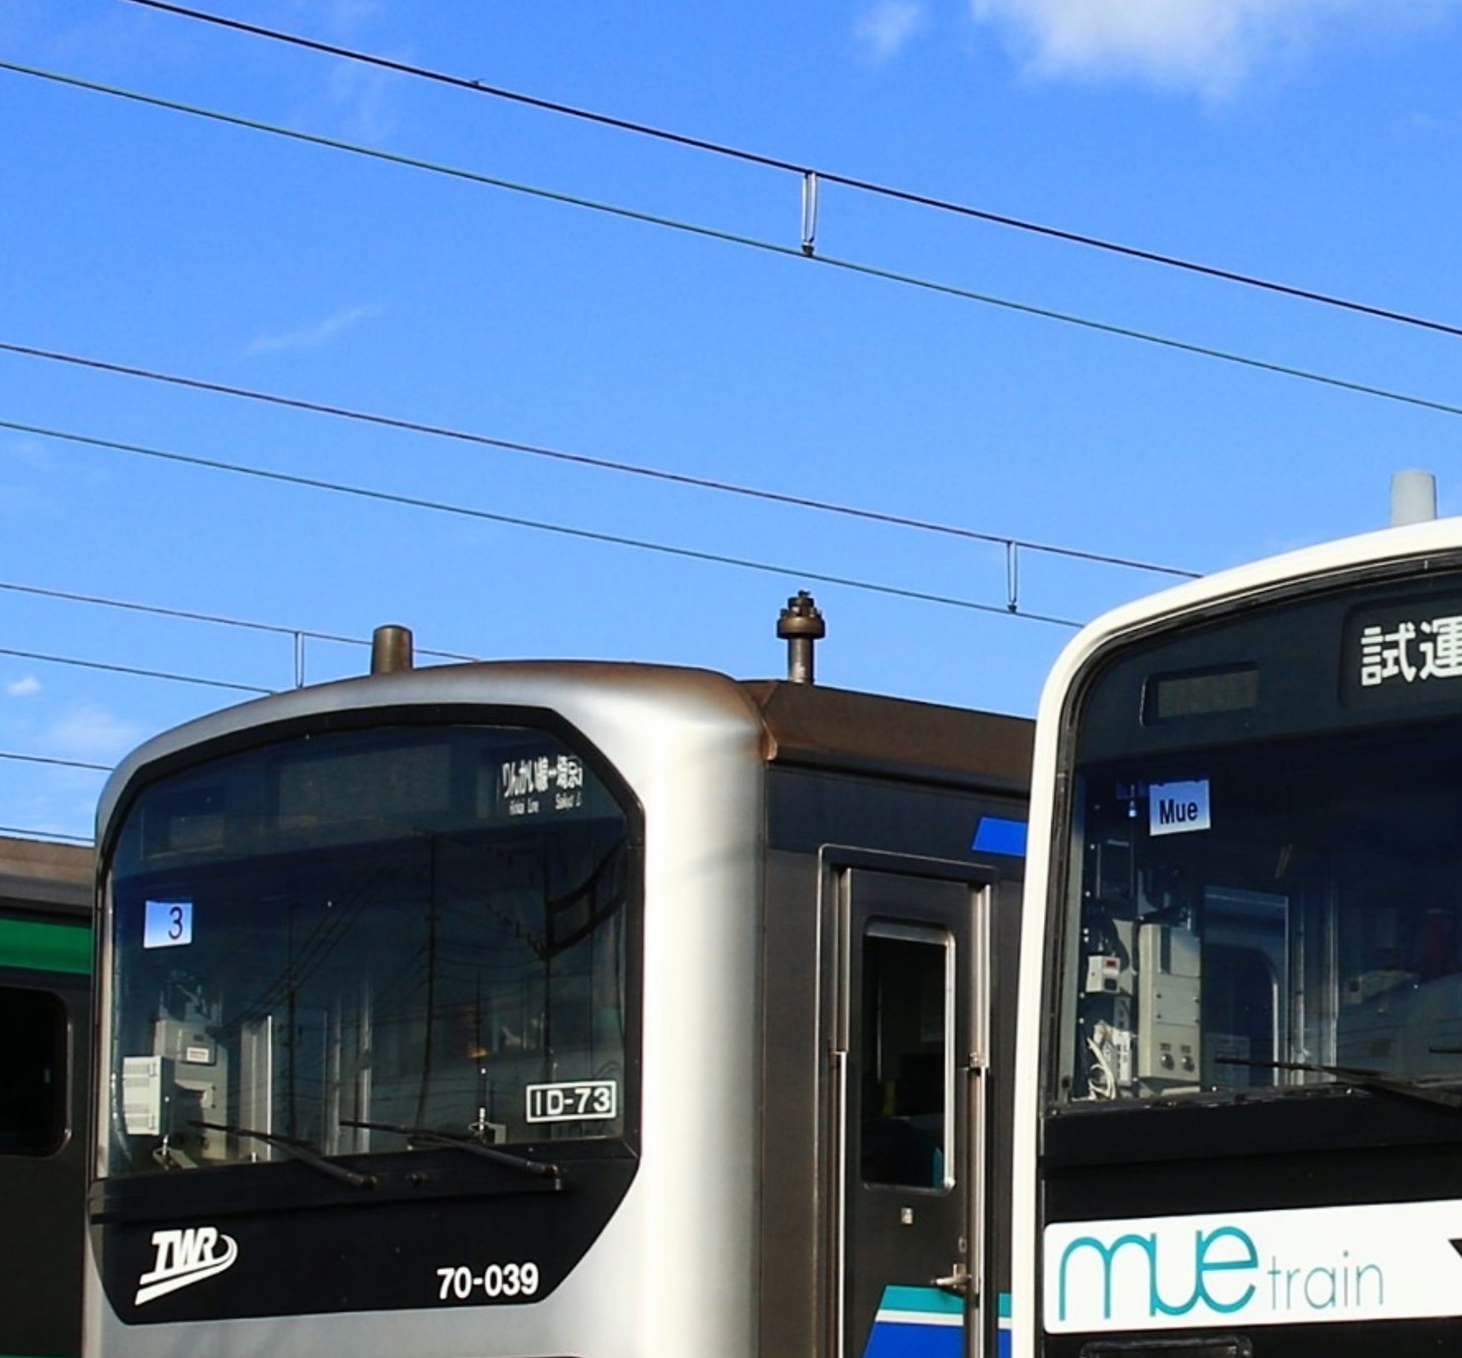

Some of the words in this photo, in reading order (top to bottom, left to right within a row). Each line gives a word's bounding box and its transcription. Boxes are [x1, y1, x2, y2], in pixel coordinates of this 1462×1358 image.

[1159, 798, 1199, 825] Mue
[168, 906, 183, 940] 3
[535, 1085, 611, 1116] ID-73
[436, 1263, 539, 1301] 70-039
[1058, 1226, 1260, 1322] mue
[1268, 1251, 1385, 1311] train
